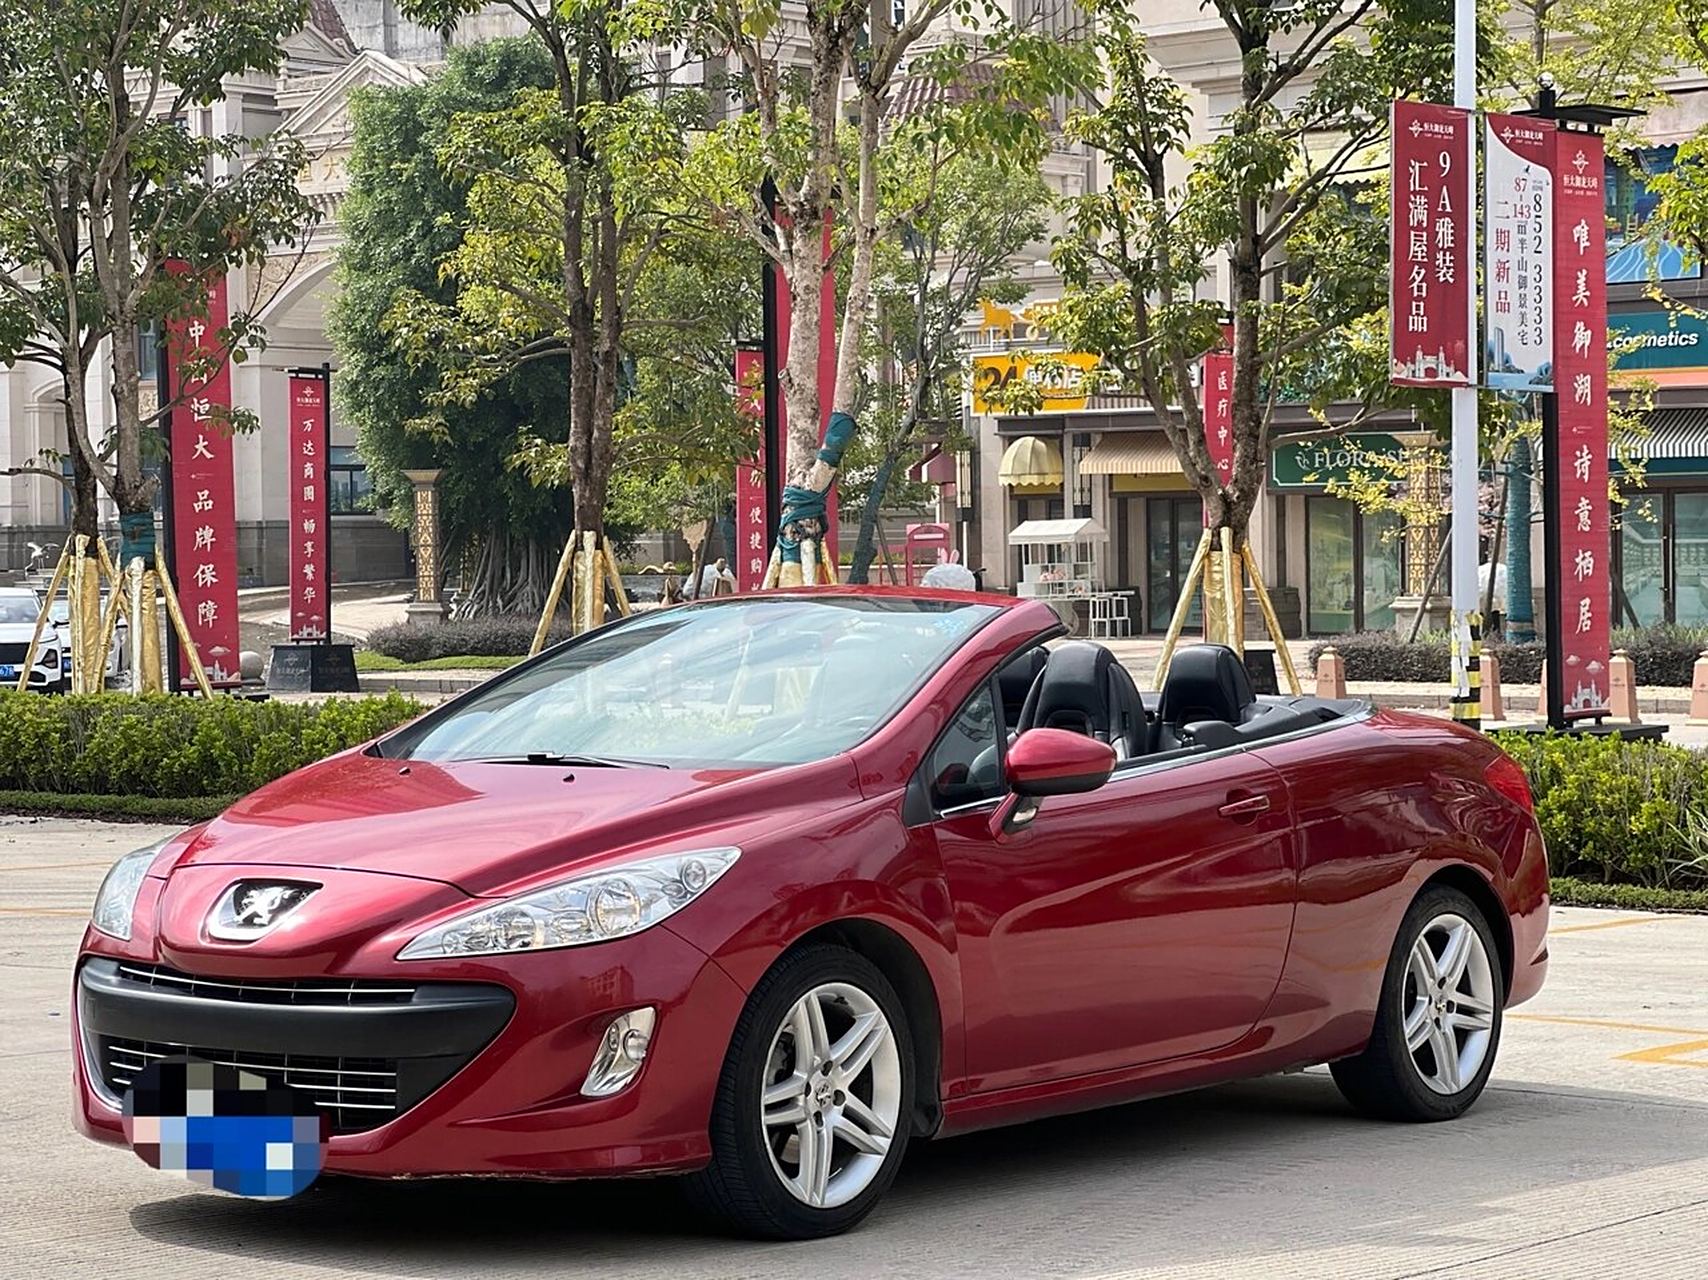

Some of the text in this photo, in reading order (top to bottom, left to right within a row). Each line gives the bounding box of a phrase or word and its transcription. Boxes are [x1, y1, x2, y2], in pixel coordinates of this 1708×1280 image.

[1408, 159, 1429, 333] 汇满屋名品
[1435, 151, 1455, 284] 9A雅装
[1495, 200, 1511, 314] 二期新品
[1572, 219, 1592, 406] 唯美御湖
[1217, 370, 1229, 471] 医疗中心
[192, 489, 219, 629] 品牌保障
[302, 518, 316, 605] 畅享繁华
[1574, 444, 1594, 634] 诗意栖居
